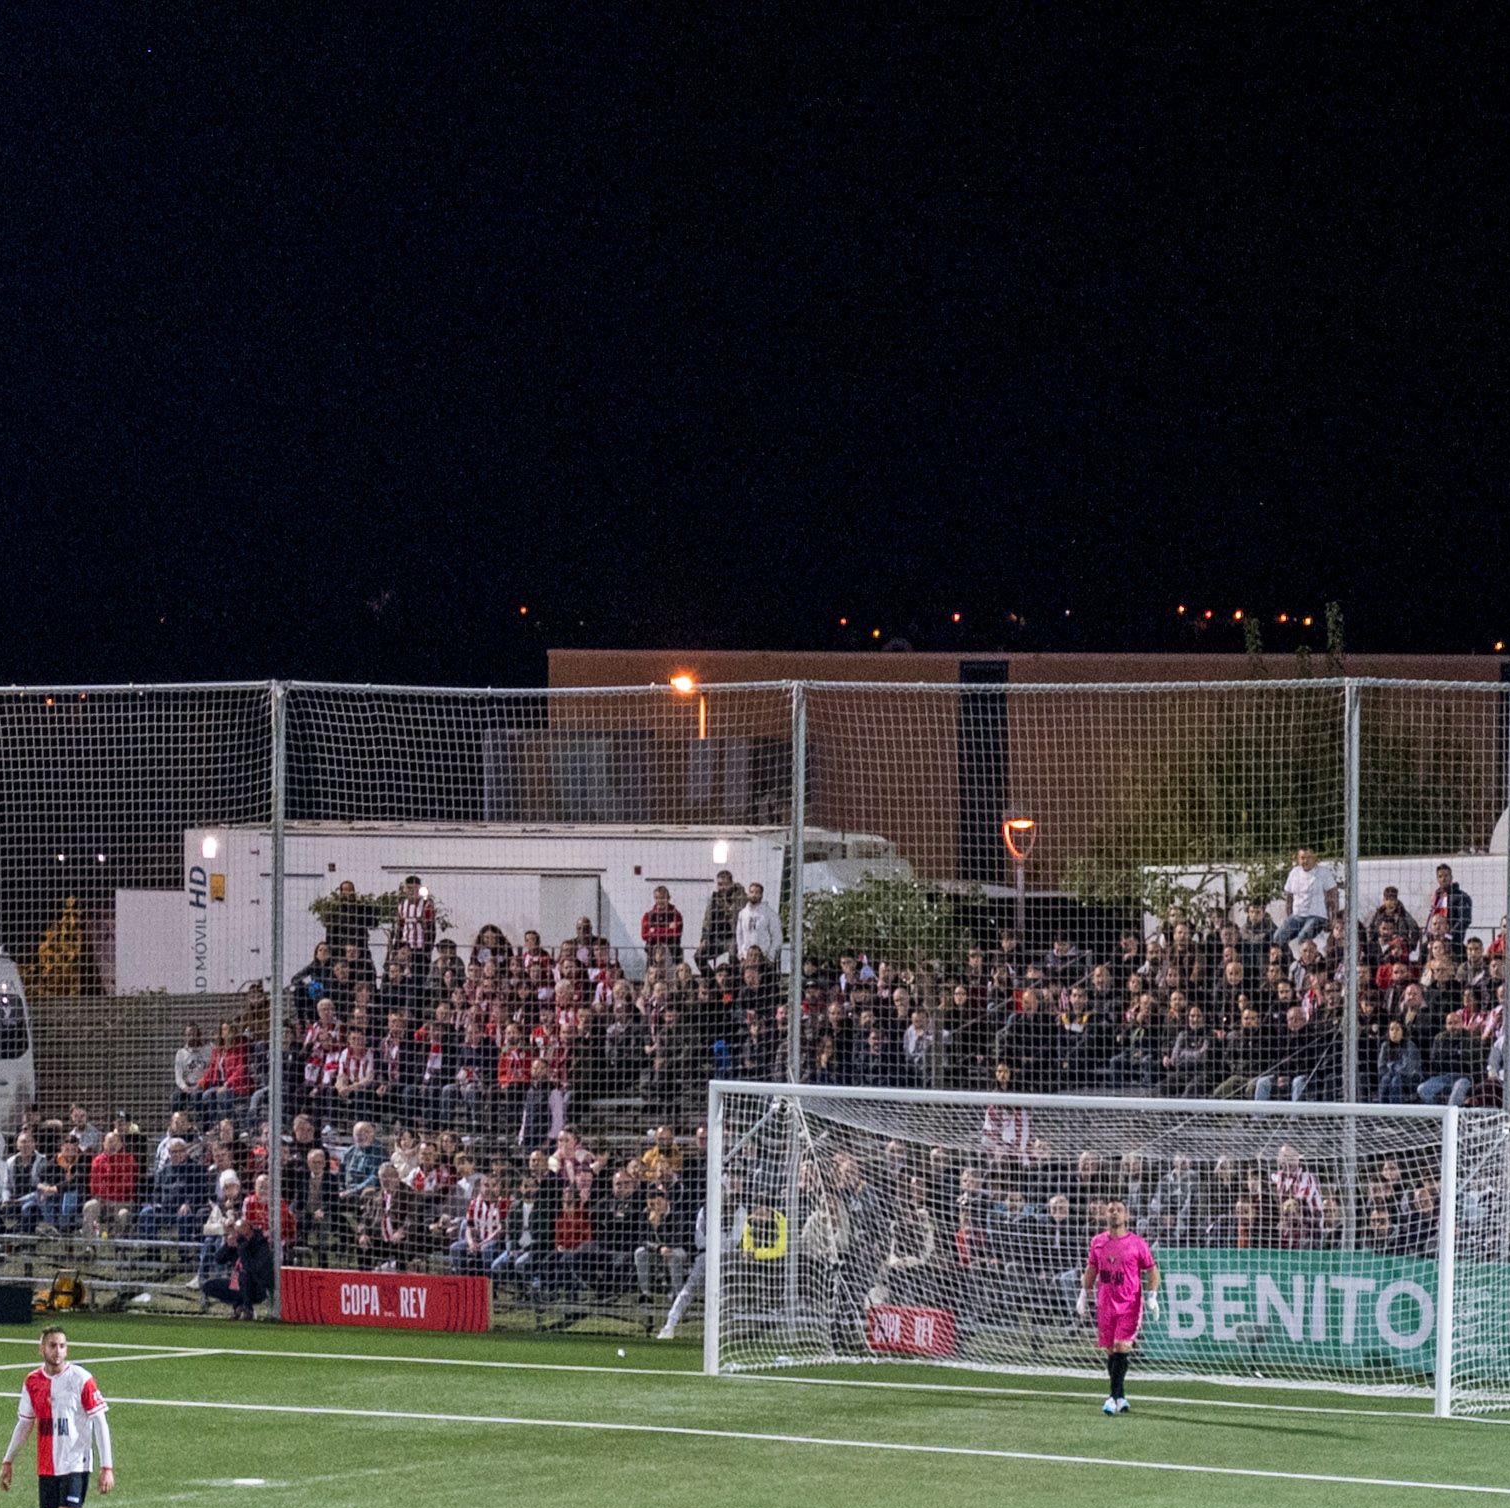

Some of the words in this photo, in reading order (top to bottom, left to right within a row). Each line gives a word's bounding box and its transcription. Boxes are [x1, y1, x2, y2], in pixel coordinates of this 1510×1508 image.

[189, 865, 207, 909] HD
[192, 918, 208, 971] MÓVIL
[341, 1283, 380, 1316] COPA
[399, 1286, 427, 1319] REY
[1164, 1273, 1435, 1350] BENITO
